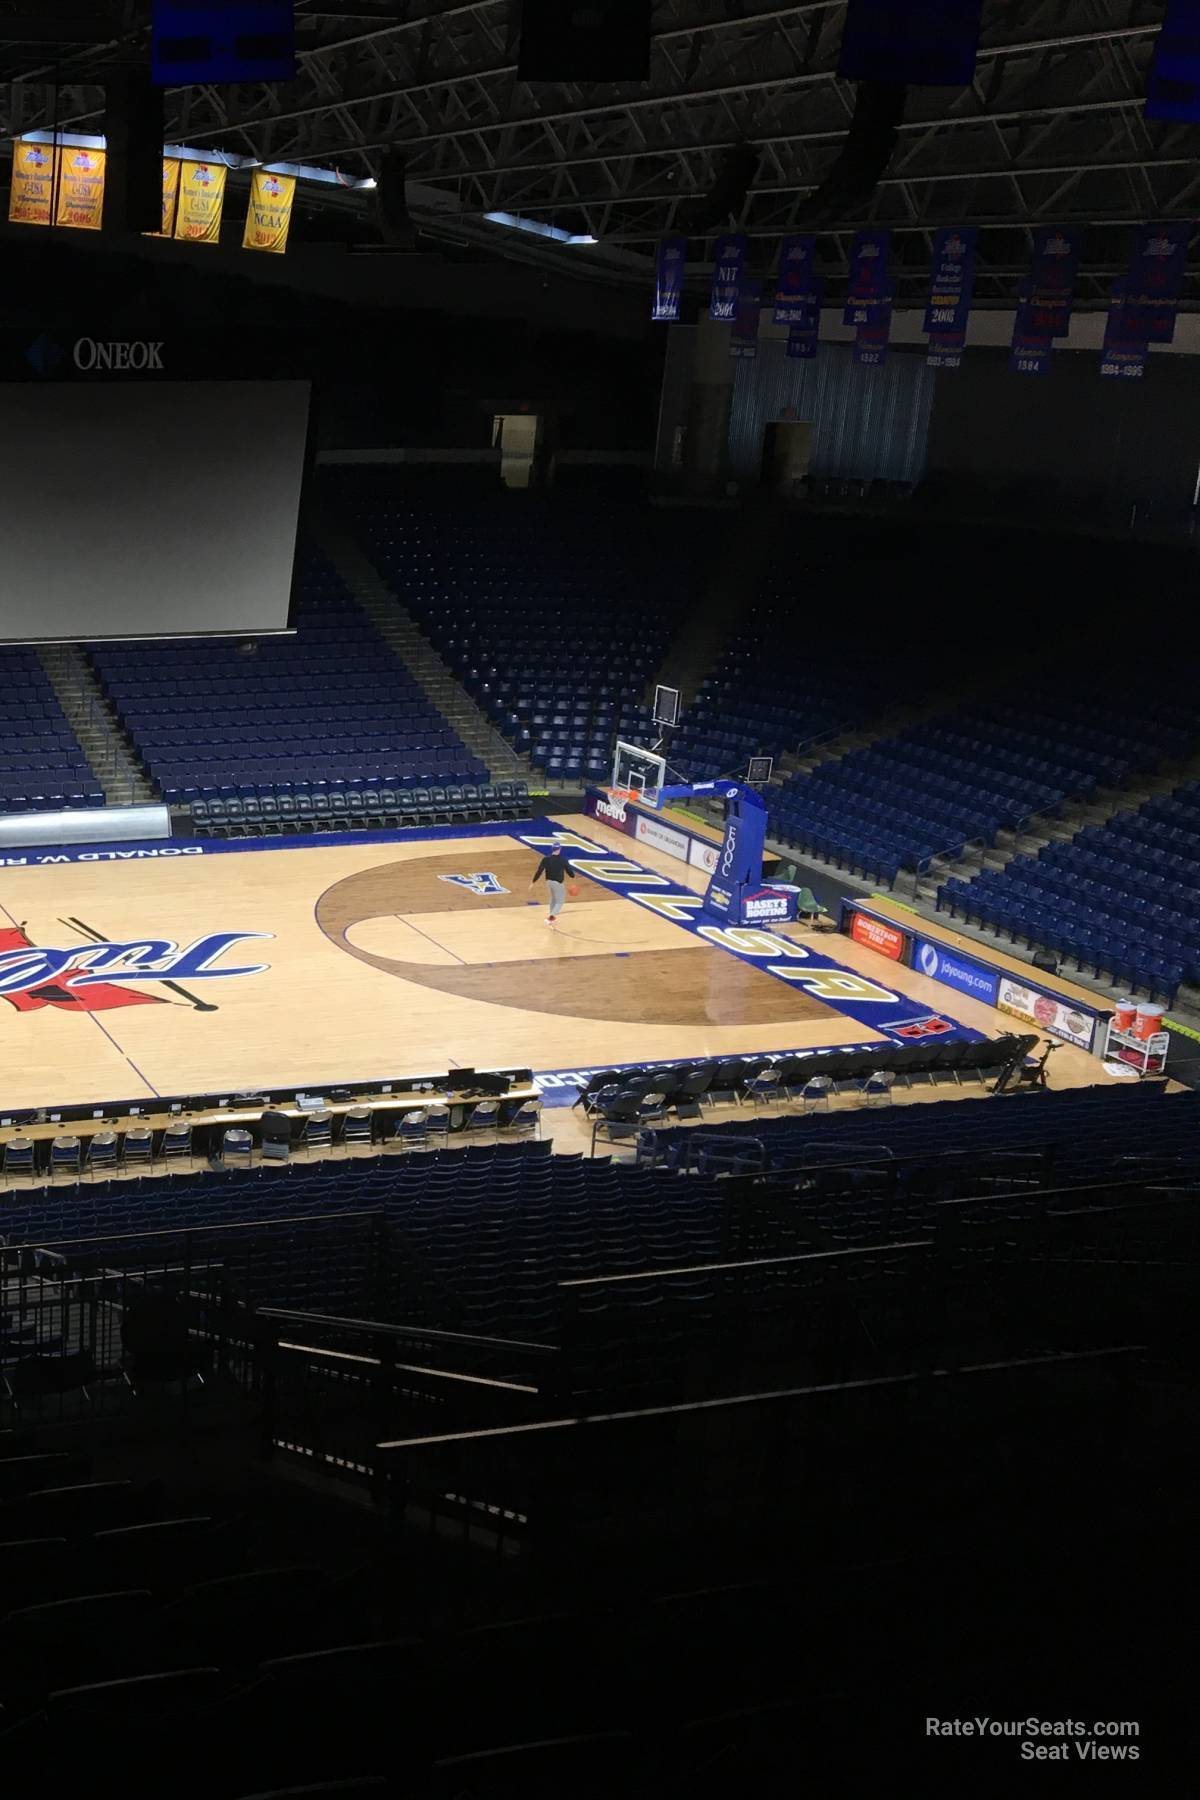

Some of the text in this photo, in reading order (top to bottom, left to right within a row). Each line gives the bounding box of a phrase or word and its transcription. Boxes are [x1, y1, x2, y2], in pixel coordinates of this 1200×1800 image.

[254, 213, 282, 229] NCAA
[73, 337, 165, 370] ONEOK
[36, 855, 70, 865] W.
[79, 846, 204, 861] DONALD
[519, 832, 900, 1002] TULSA
[746, 908, 787, 918] ROOFING
[857, 919, 898, 943] ROBERTSON
[941, 960, 993, 992] jdyoung.com
